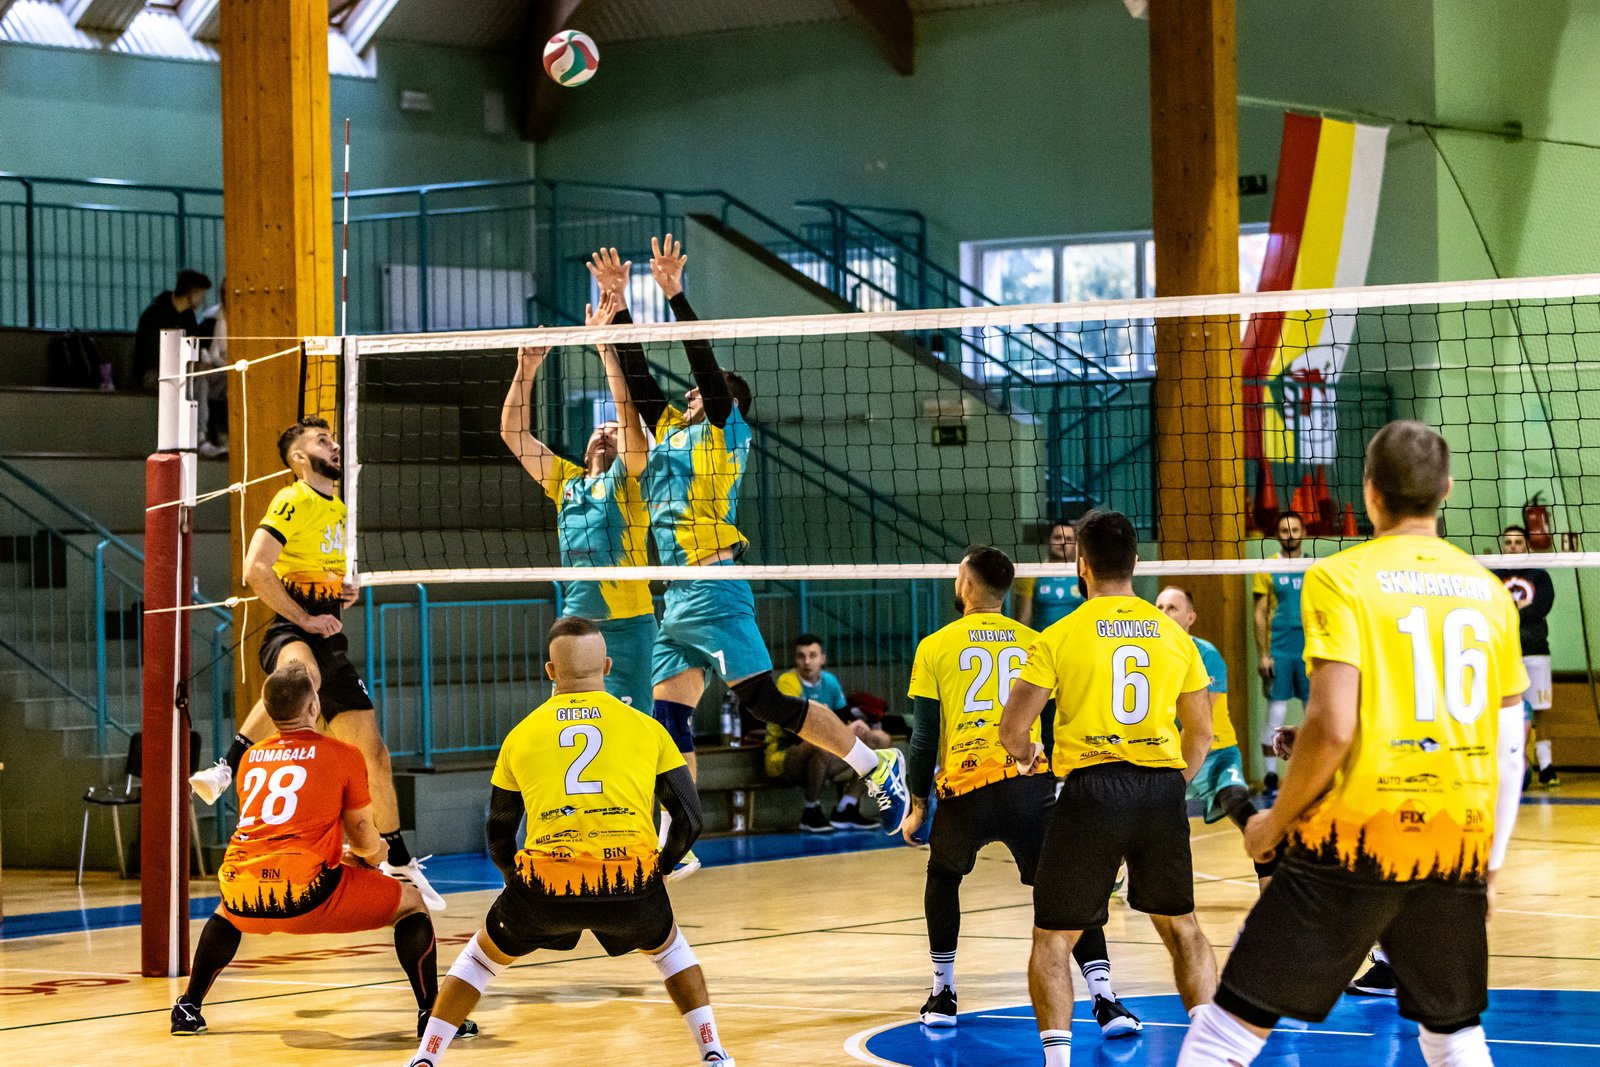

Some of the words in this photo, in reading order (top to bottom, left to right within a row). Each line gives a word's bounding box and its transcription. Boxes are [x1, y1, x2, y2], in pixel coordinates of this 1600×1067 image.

[968, 629, 1017, 643] KUBIAK
[1096, 620, 1160, 638] GŁOWACZ
[1396, 605, 1490, 726] 16
[959, 646, 1027, 714] 26
[1111, 644, 1150, 725] 6
[556, 706, 602, 721] GIERA
[248, 745, 316, 763] DOMAGAŁA
[558, 724, 604, 796] 2
[961, 759, 978, 768] FIX
[1377, 776, 1401, 785] AUTO
[236, 765, 308, 829] 28
[1400, 810, 1426, 824] FIX
[603, 846, 627, 859] BiN
[261, 868, 280, 879] BiN
